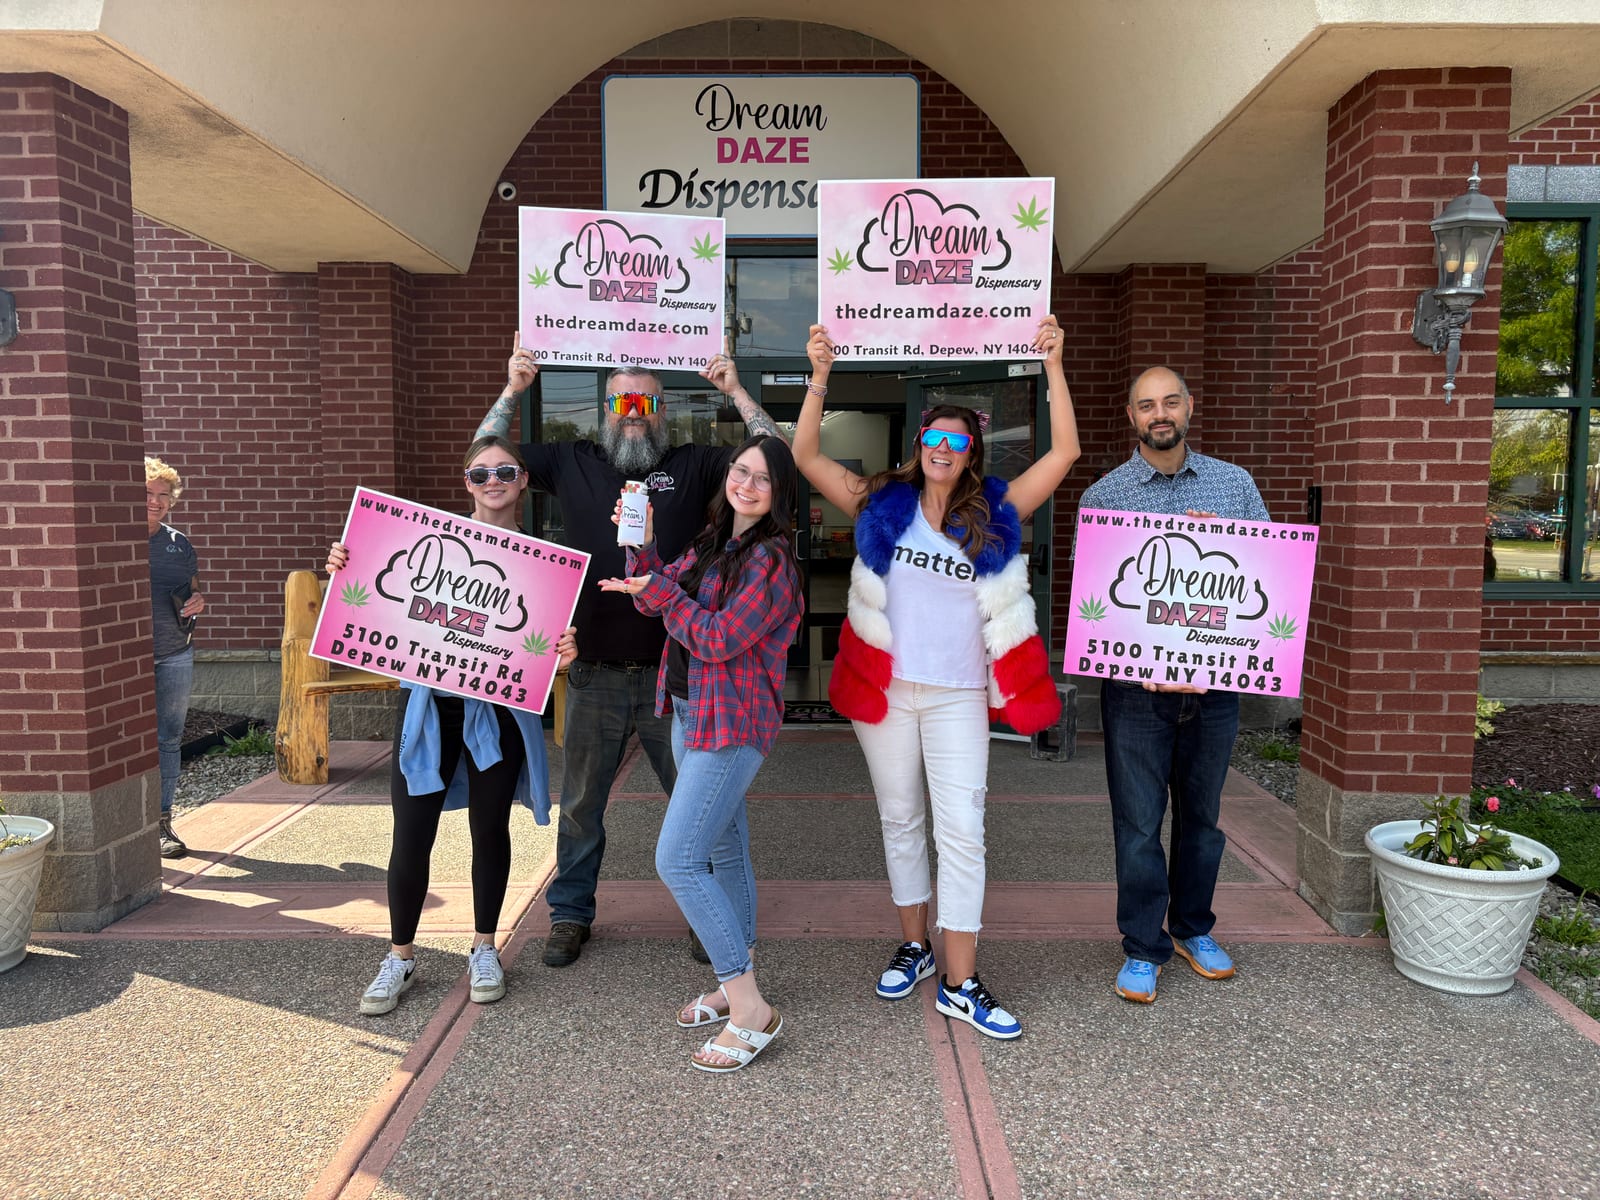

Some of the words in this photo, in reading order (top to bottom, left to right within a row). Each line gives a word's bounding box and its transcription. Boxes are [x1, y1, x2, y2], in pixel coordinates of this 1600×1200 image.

[695, 83, 828, 132] Dream
[716, 136, 810, 164] DAZE
[639, 167, 818, 217] Dispens
[881, 193, 992, 257] Dream
[575, 222, 673, 280] Dream
[895, 259, 974, 286] DAZE
[975, 275, 1042, 291] Dispensary
[589, 279, 658, 304] DAZE
[659, 297, 717, 312] Dispensary
[535, 314, 709, 336] thedreamdaze.com
[835, 302, 1032, 320] thedreamdaze.com
[552, 350, 593, 363] Transit
[620, 354, 664, 367] Depew,
[668, 356, 685, 366] NY
[688, 356, 707, 367] 140
[853, 344, 899, 356] Transit
[929, 344, 979, 358] Depew,
[983, 343, 1003, 355] NY
[359, 497, 582, 571] www.thedreamdaze.com
[1081, 513, 1316, 542] www.thedreamdaze.com
[407, 533, 512, 615] Dream
[1136, 535, 1249, 604] Dream
[407, 594, 489, 637] DAZE
[1146, 599, 1228, 631] DAZE
[342, 623, 399, 651] 5100
[408, 640, 489, 675] Transit
[496, 663, 524, 684] Rd
[442, 629, 514, 660] Dispensary
[1185, 628, 1260, 651] Dispensary
[330, 639, 406, 673] Depew
[416, 661, 449, 683] NY
[458, 672, 528, 704] 14043
[1087, 639, 1143, 659] 5100
[1153, 645, 1237, 669] Transit
[1246, 655, 1274, 673] Rd
[1078, 656, 1154, 679] Depew
[1165, 666, 1198, 684] NY
[1208, 670, 1282, 692] 14043
